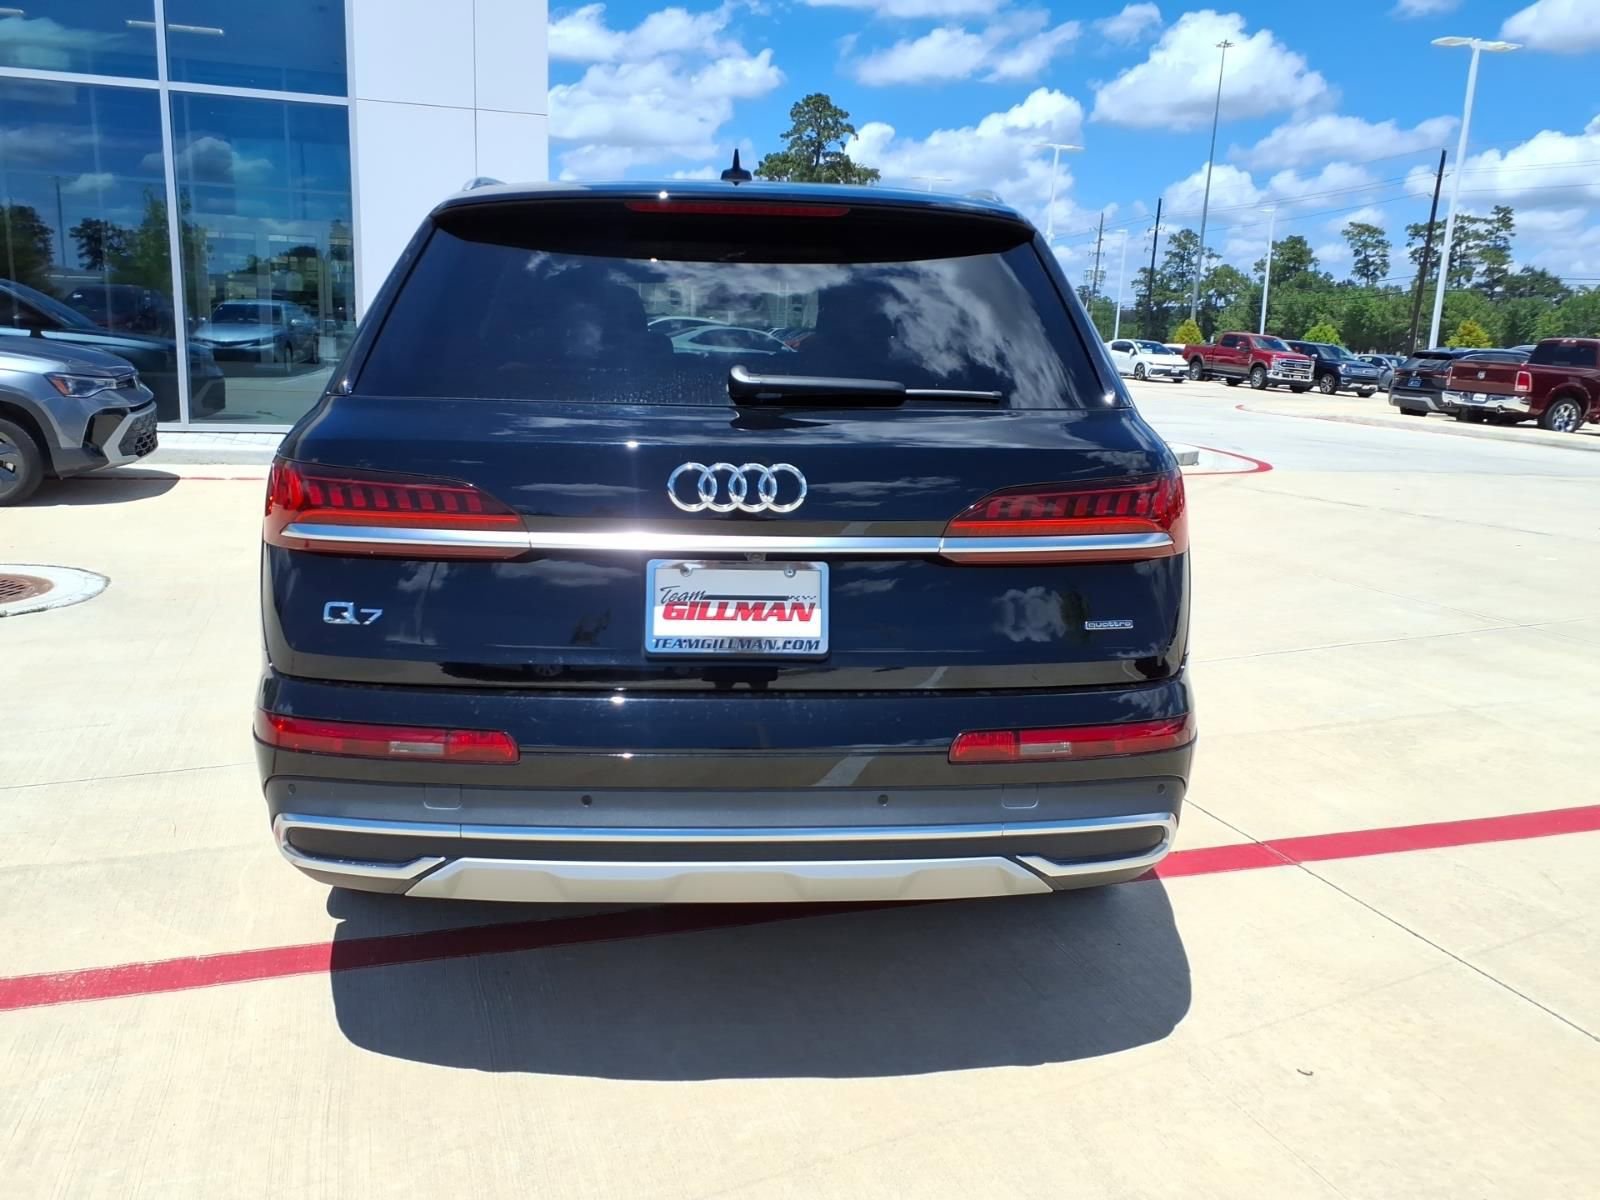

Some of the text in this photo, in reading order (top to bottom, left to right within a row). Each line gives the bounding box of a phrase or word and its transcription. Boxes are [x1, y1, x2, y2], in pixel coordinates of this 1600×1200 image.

[660, 585, 706, 604] Team
[323, 601, 383, 625] Q7
[662, 601, 816, 621] GILLMAN
[1087, 620, 1132, 629] quattro
[654, 638, 820, 650] TEAMGILLMAN.COM
